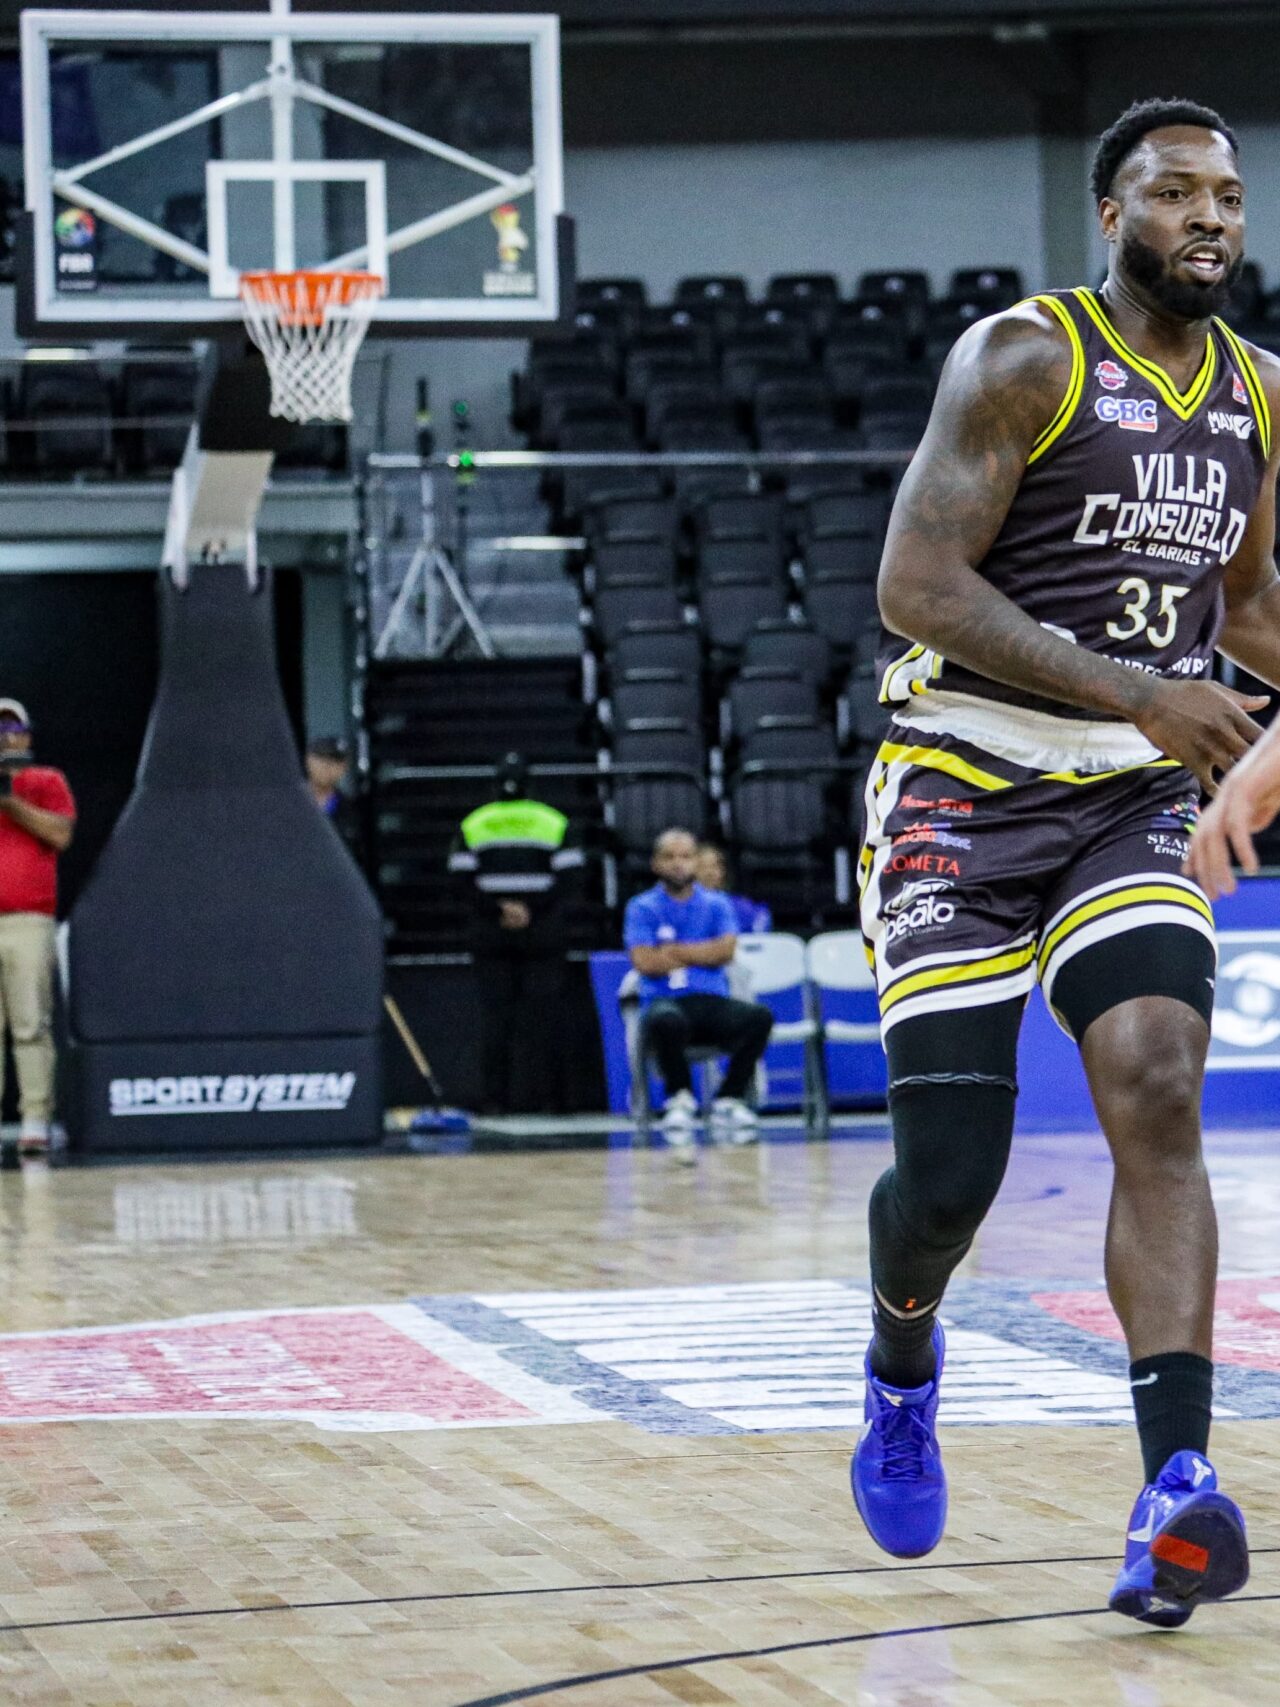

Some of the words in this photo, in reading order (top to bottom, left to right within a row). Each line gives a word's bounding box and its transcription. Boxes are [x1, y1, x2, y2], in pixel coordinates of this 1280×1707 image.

[1094, 395, 1158, 426] GBC
[1131, 453, 1228, 510] VILLA
[1072, 492, 1248, 567] CONSUELO
[1121, 539, 1143, 554] EL
[1145, 542, 1202, 566] BARIAS
[1105, 577, 1192, 649] 35
[108, 1071, 357, 1114] SPORTSYSTEM
